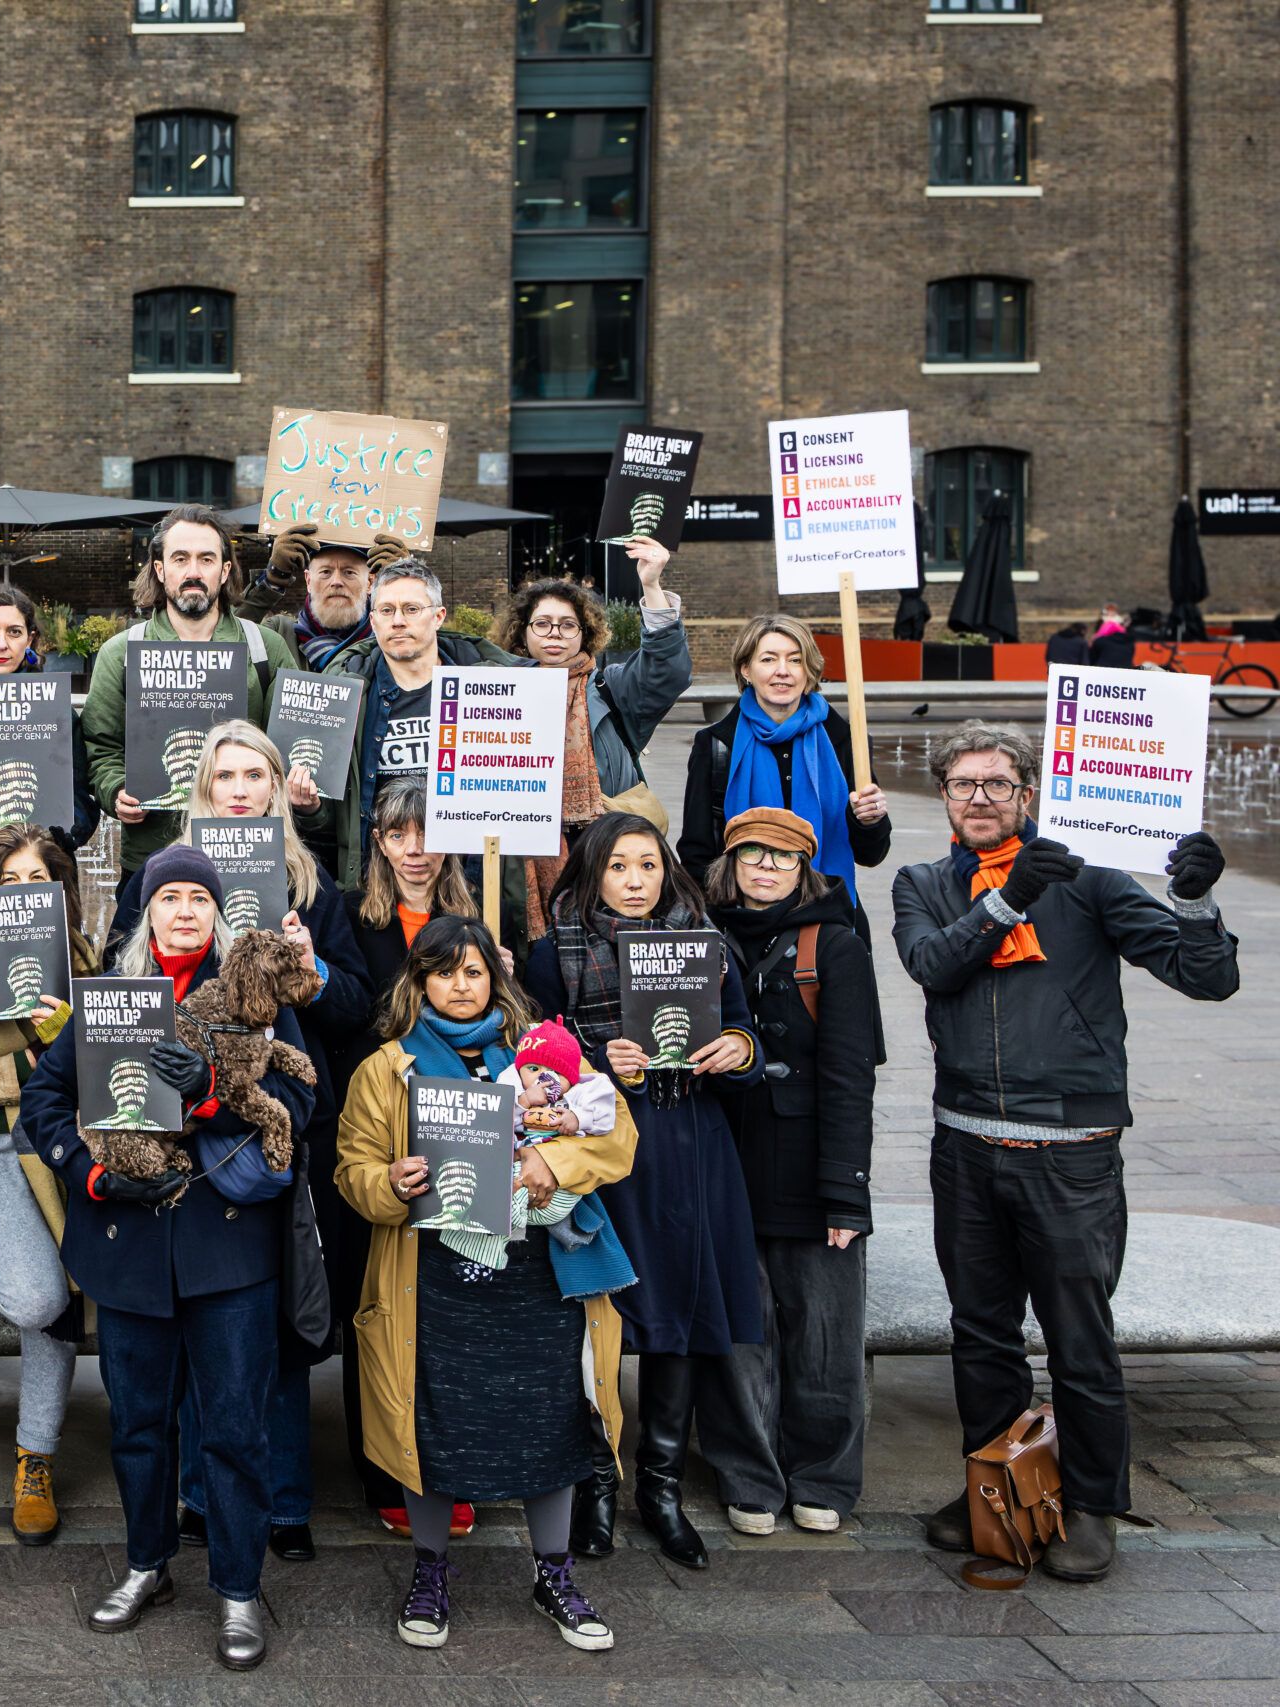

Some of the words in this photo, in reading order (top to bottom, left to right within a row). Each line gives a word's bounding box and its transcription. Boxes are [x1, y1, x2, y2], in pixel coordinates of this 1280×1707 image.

[277, 415, 433, 477] Justice
[626, 432, 665, 451] BRAVE
[666, 438, 693, 455] NEW
[803, 431, 854, 446] CONSENT
[625, 447, 672, 466] WORLD?
[804, 453, 863, 468] LICENSING
[329, 476, 381, 496] for
[806, 476, 851, 490] ETHICAL
[854, 474, 876, 487] USE
[807, 494, 902, 512] ACCOUNTABILITY
[268, 488, 423, 538] Creators
[808, 518, 896, 534] REMUNERATION
[786, 549, 906, 562] #JusticeForCreators
[140, 650, 192, 669] BRAVE
[196, 651, 233, 669] NEW
[140, 670, 207, 689] WORLD?
[21, 682, 57, 701] NEW
[282, 678, 321, 697] BRAVE
[322, 684, 351, 701] NEW
[465, 683, 516, 696] CONSENT
[1085, 684, 1146, 701] CONSENT
[282, 692, 329, 712] WORLD?
[464, 707, 522, 720] LICENSING
[1084, 709, 1153, 728] LICENSING
[463, 731, 507, 744] ETHICAL
[511, 732, 532, 744] USE
[1082, 734, 1135, 752] ETHICAL
[1139, 740, 1165, 754] USE
[461, 754, 555, 768] ACCOUNTABILITY
[1080, 759, 1193, 783] ACCOUNTABILITY
[460, 779, 546, 792] REMUNERATION
[1079, 785, 1182, 808] REMUNERATION
[435, 810, 552, 823] #JusticeForCreators
[201, 828, 242, 842] BRAVE
[245, 828, 273, 842] NEW
[201, 843, 254, 858] WORLD?
[25, 893, 53, 909] NEW
[629, 943, 673, 958] BRAVE
[676, 942, 707, 958] NEW
[630, 959, 685, 974] WORLD?
[83, 991, 128, 1008] BRAVE
[131, 991, 163, 1008] NEW
[84, 1009, 141, 1025] WORLD?
[417, 1087, 464, 1108] BRAVE
[467, 1092, 501, 1111] NEW
[417, 1105, 476, 1126] WORLD?
[417, 1125, 444, 1133] JUSTICE
[462, 1129, 498, 1138] CREATORS
